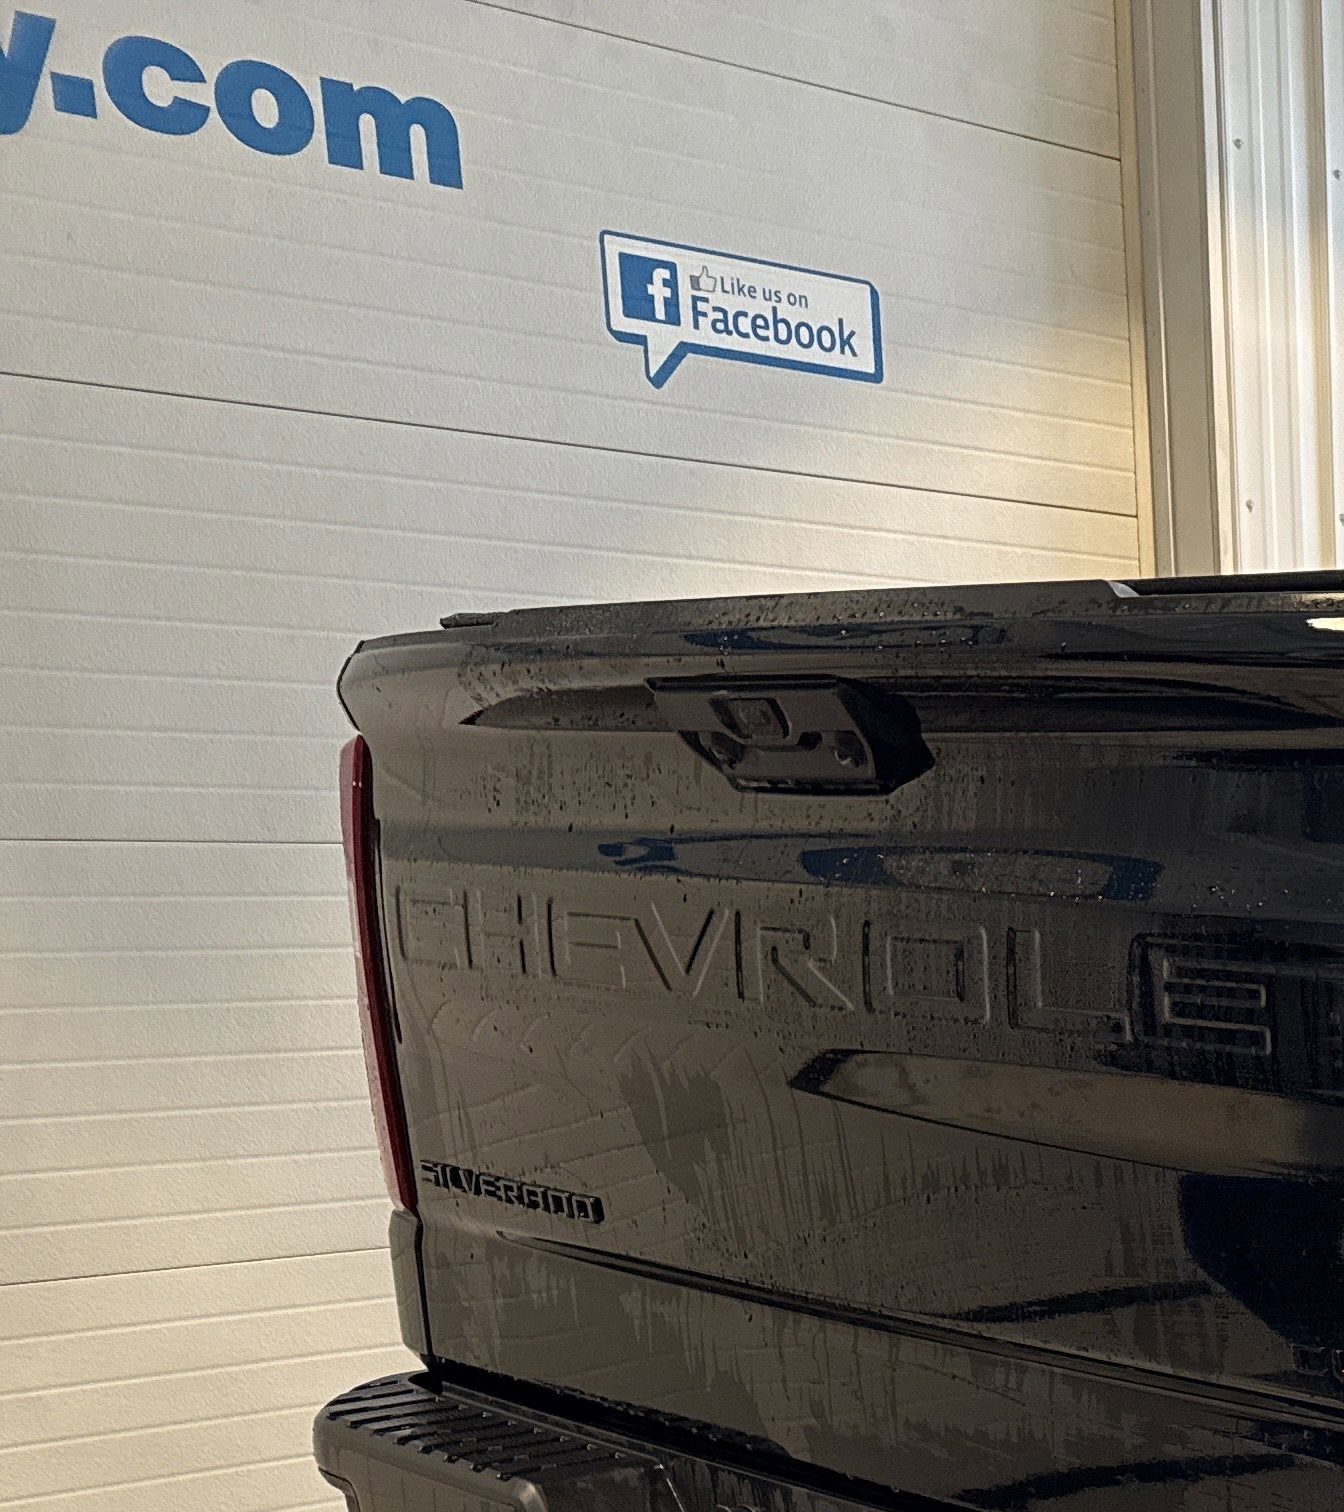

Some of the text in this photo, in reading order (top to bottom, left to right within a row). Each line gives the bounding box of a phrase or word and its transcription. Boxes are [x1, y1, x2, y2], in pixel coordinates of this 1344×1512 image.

[719, 276, 809, 309] Like us on
[690, 294, 858, 357] Facebook
[419, 1158, 606, 1226] SILVERADO
